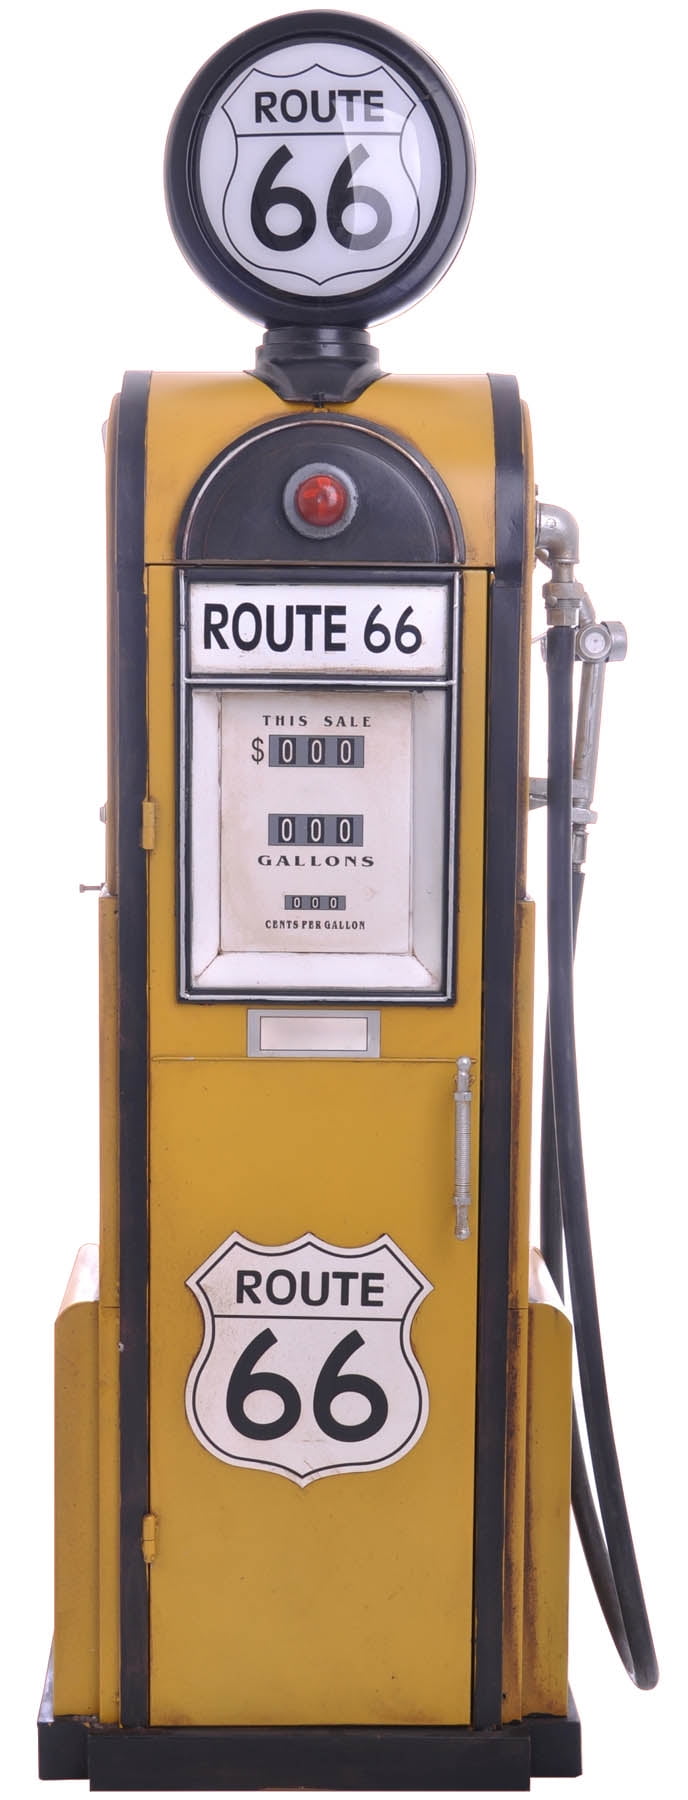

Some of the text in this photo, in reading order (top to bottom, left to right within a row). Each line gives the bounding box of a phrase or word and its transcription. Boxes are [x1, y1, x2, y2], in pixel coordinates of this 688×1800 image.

[254, 89, 385, 123] ROUTE
[250, 143, 393, 252] 66
[203, 602, 423, 654] ROUTE 66
[262, 715, 372, 728] THIS SALE
[257, 855, 374, 868] GALLONS
[265, 919, 366, 930] CENTS PER GALLON
[235, 1269, 385, 1307] ROUTE
[226, 1327, 389, 1443] 66
